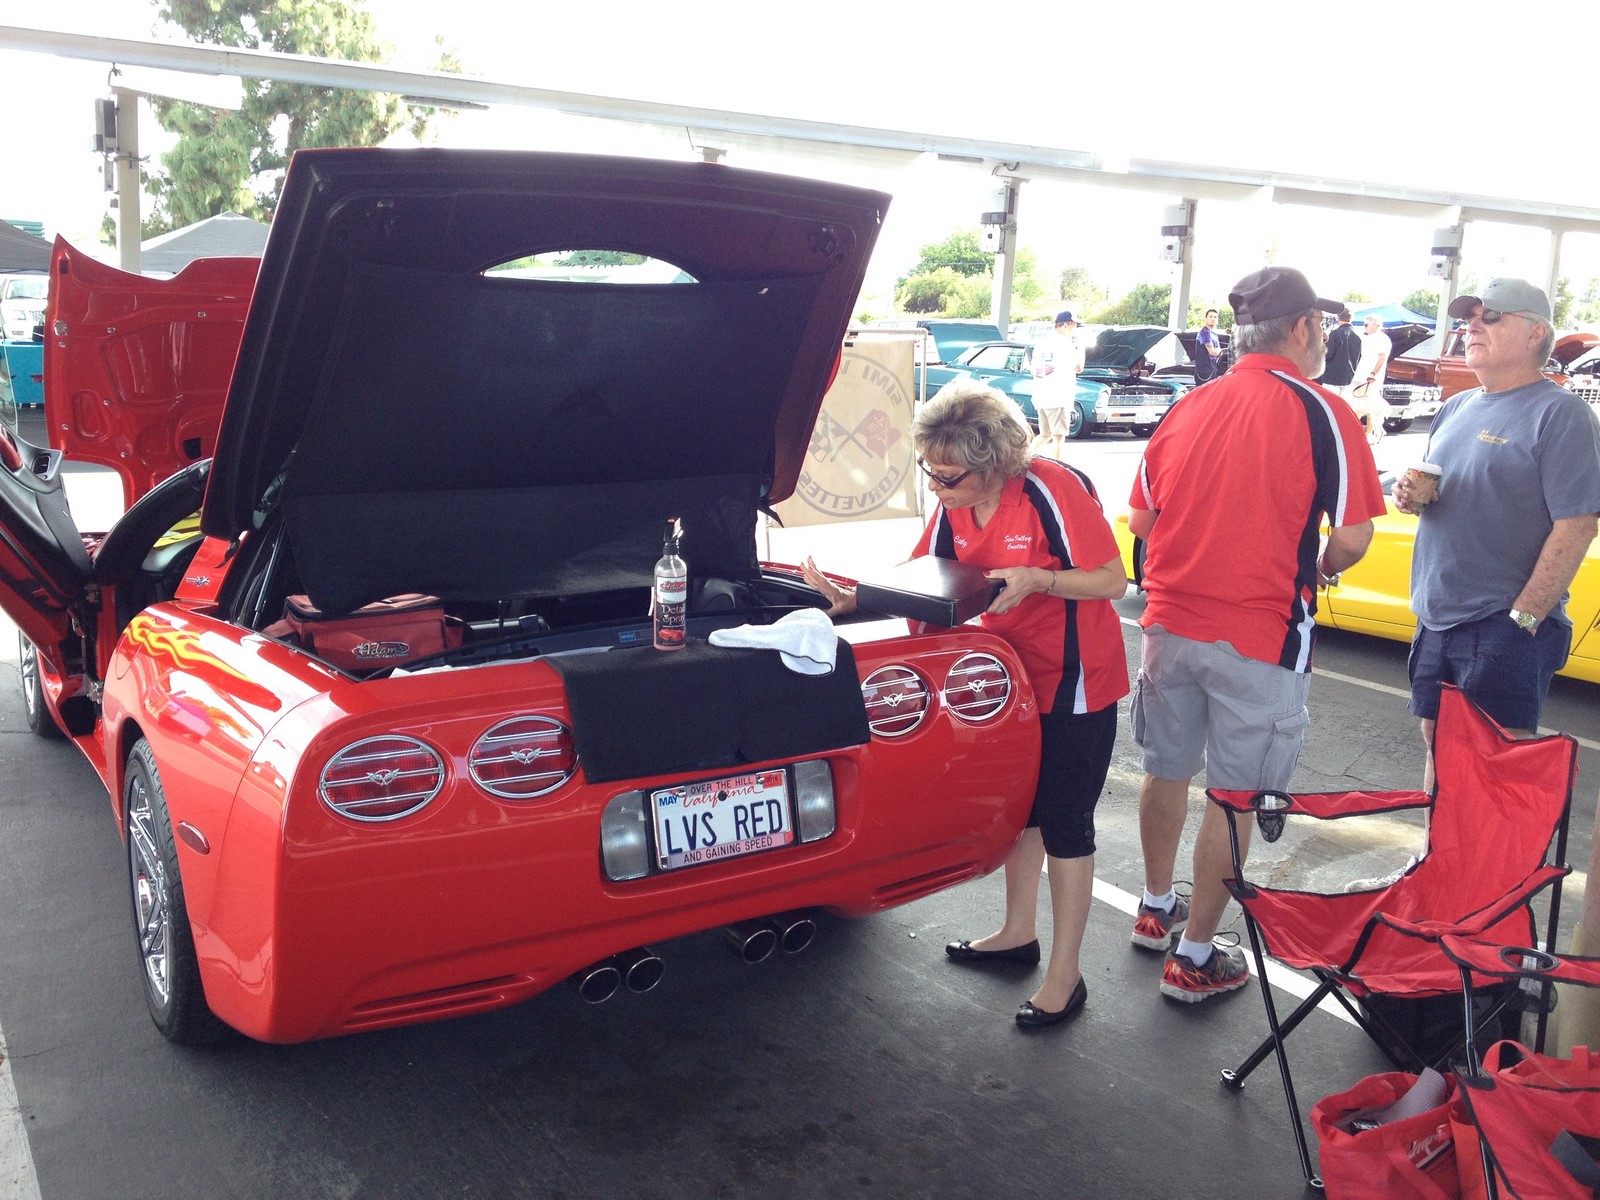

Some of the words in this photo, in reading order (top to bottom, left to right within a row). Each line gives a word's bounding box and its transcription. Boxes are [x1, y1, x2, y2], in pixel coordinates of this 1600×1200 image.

[682, 785, 763, 808] Califrnia
[690, 785, 712, 795] OVER
[716, 781, 731, 791] THE
[735, 778, 753, 788] HILL
[659, 795, 678, 807] MAY
[665, 811, 717, 855] LVS
[733, 799, 783, 840] RED
[684, 850, 702, 863] AND
[705, 843, 741, 859] GAINING
[745, 836, 773, 850] SPEED
